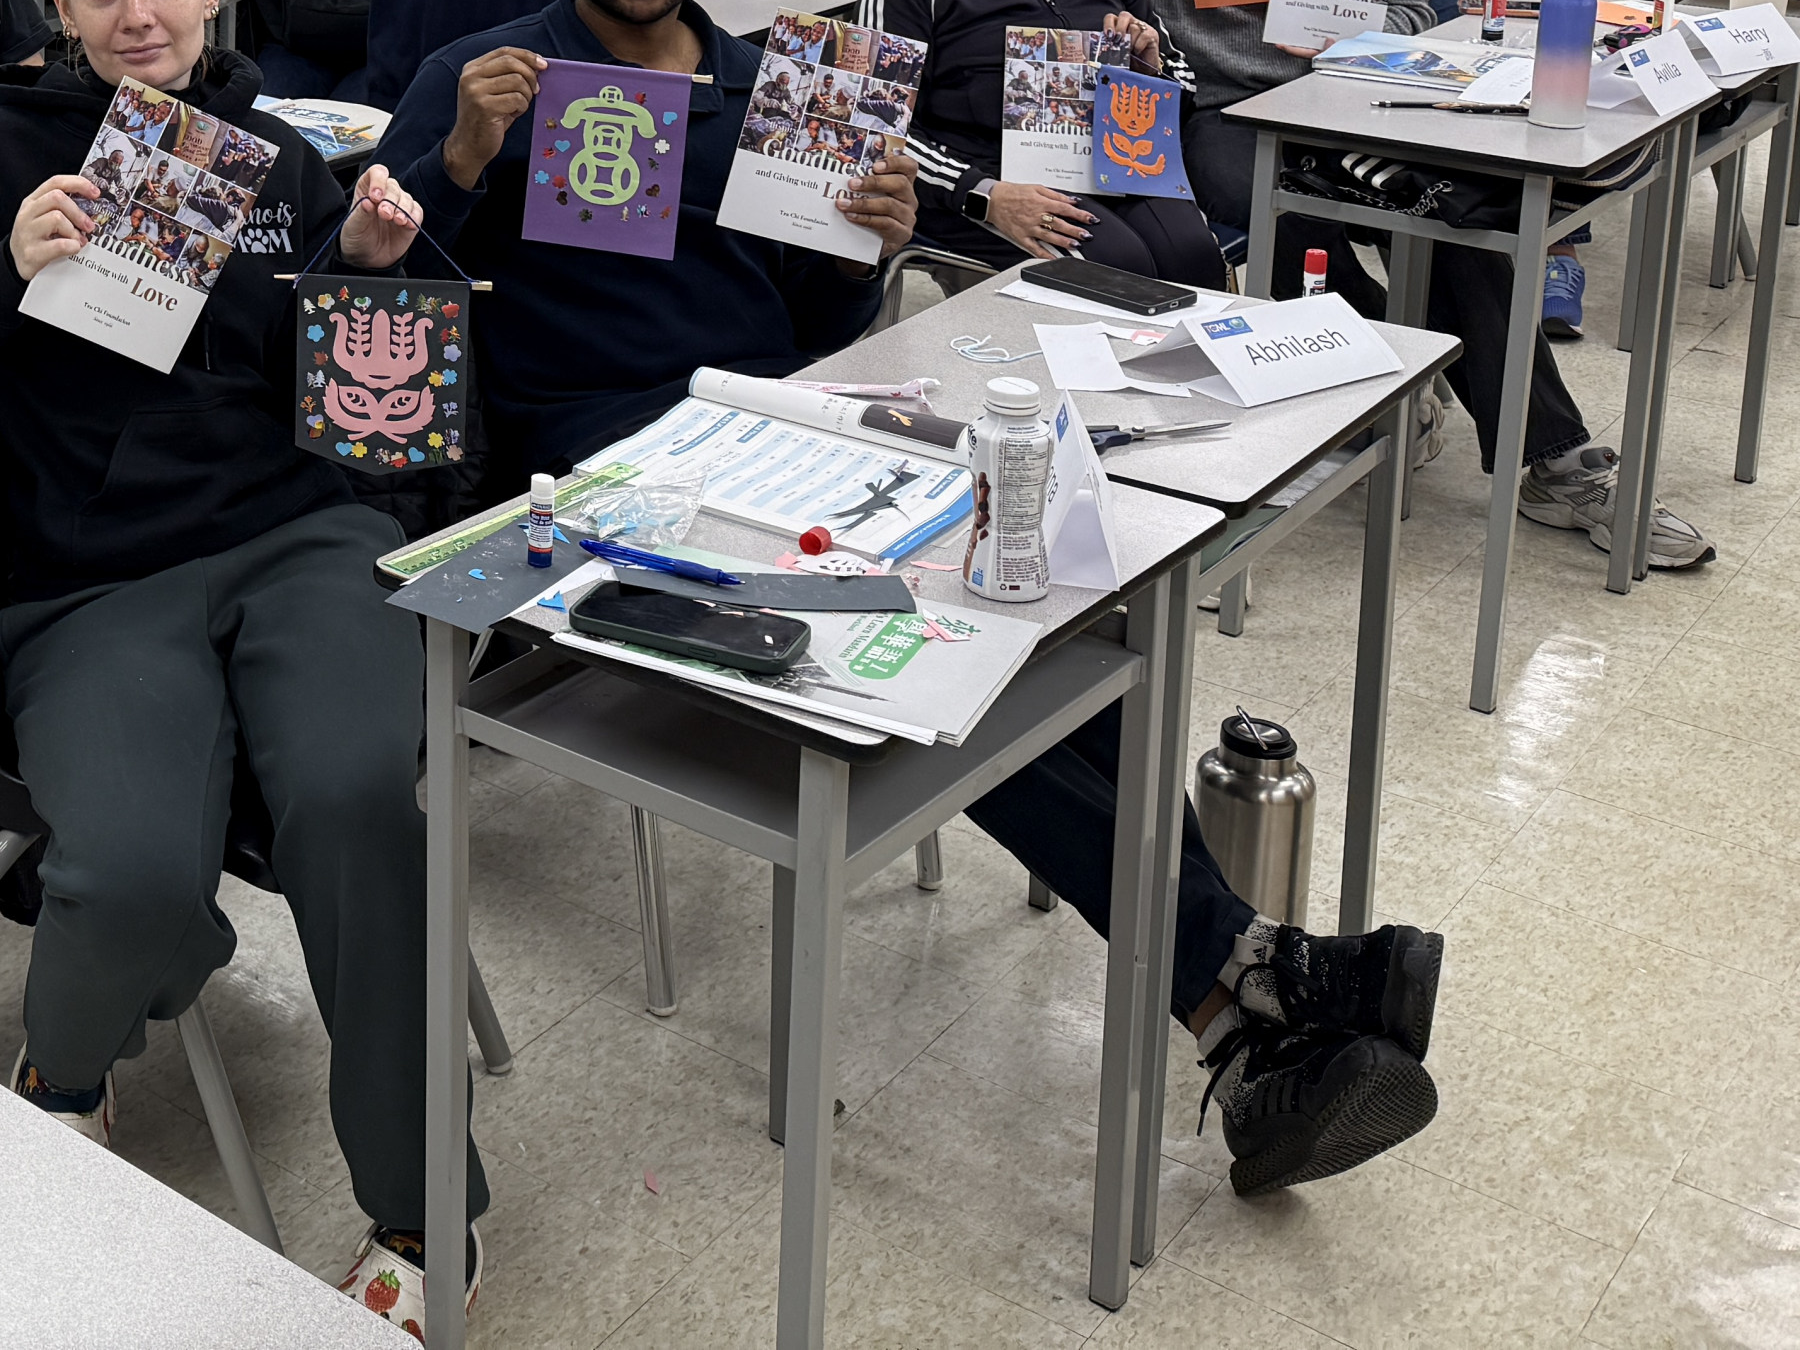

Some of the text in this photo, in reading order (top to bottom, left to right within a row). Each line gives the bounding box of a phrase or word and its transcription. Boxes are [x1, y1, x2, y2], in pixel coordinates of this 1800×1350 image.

[1333, 4, 1368, 21] Love
[1728, 27, 1770, 44] Harry
[1653, 62, 1682, 85] Avilla
[1020, 118, 1092, 137] Goodne
[1020, 140, 1033, 148] and
[1033, 141, 1054, 150] Giving
[1054, 142, 1069, 150] with
[755, 168, 771, 178] and
[773, 172, 800, 187] Giving
[800, 179, 819, 190] with
[85, 259, 110, 277] Giving
[111, 270, 129, 285] with
[130, 277, 178, 311] Love
[1204, 321, 1231, 334] TCML
[1245, 328, 1350, 366] Abhilash
[838, 619, 885, 659] Learn Mandarin
